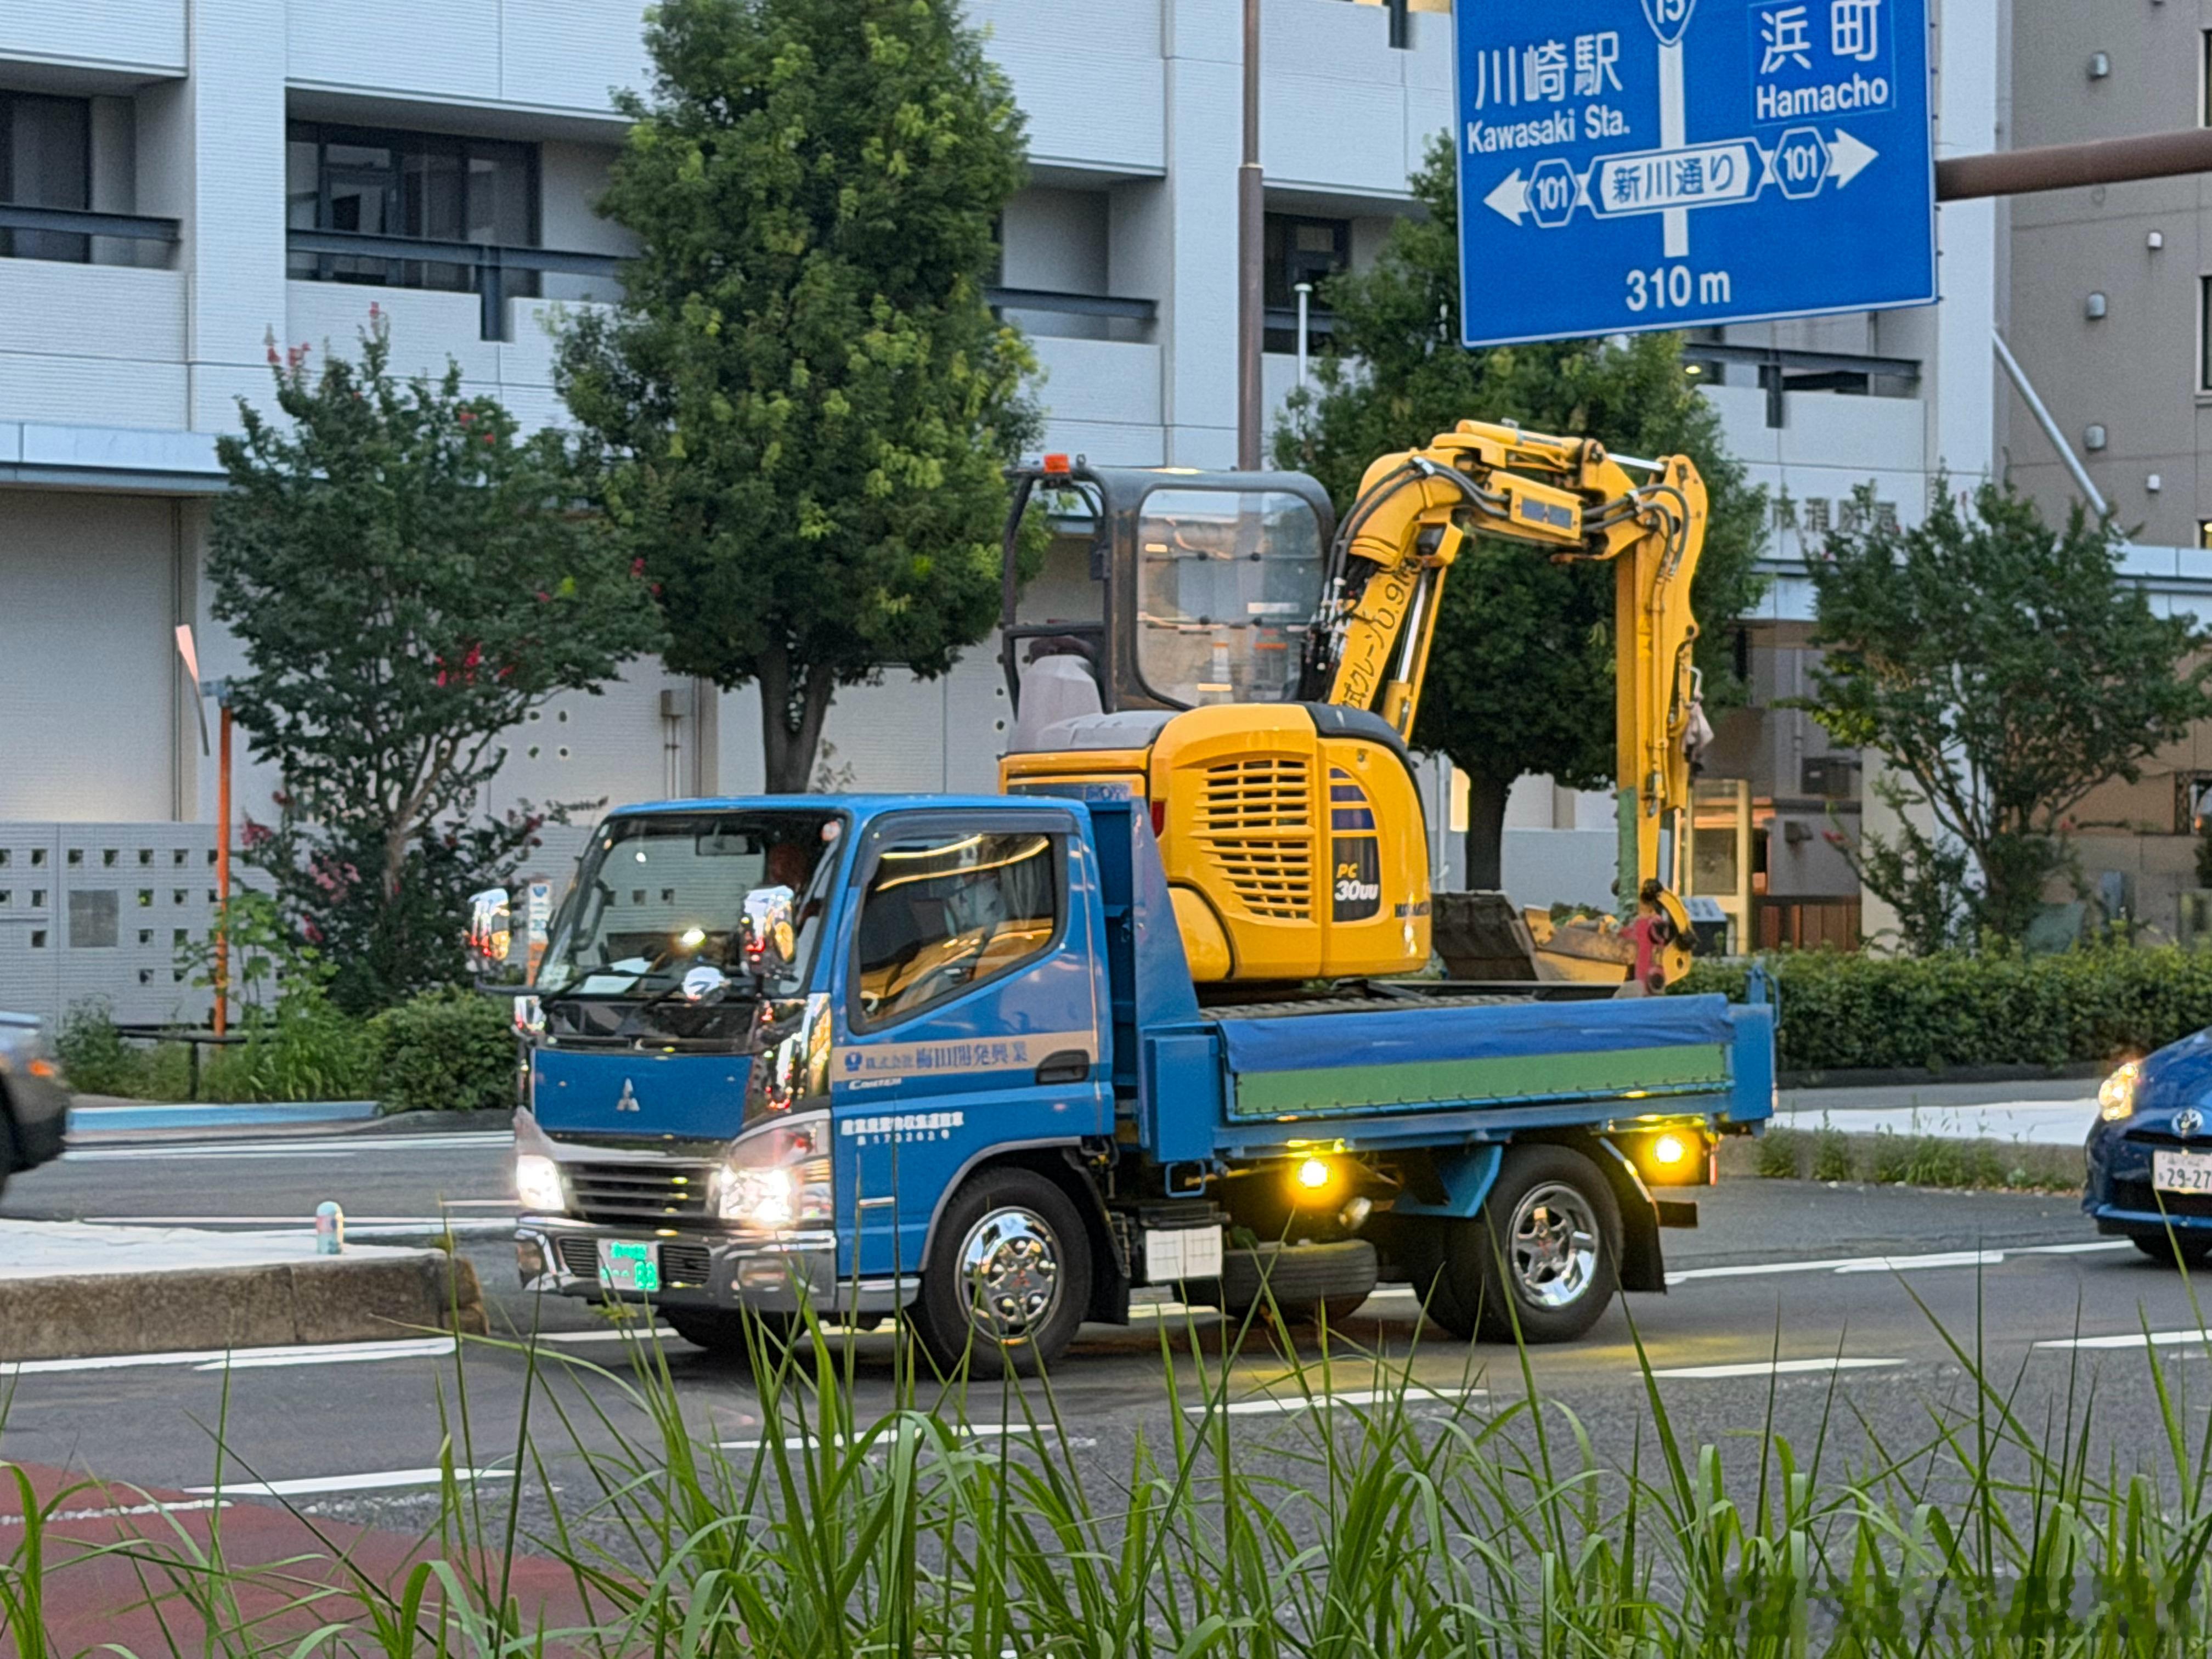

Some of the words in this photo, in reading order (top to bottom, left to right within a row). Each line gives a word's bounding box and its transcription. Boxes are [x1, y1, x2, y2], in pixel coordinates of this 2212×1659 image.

[1759, 0, 1881, 75] 浜町
[1475, 31, 1623, 110] 川崎駅
[1757, 73, 1888, 120] Hamacho
[1467, 109, 1576, 154] Kawasaki
[1584, 105, 1630, 138] Sta.
[1611, 153, 1735, 204] 新川通り
[1783, 143, 1819, 180] 101
[1536, 177, 1568, 209] 101
[1626, 264, 1691, 313] 310
[1700, 269, 1731, 304] m
[1336, 863, 1357, 878] PC
[2166, 1168, 2211, 1189] 29-27
